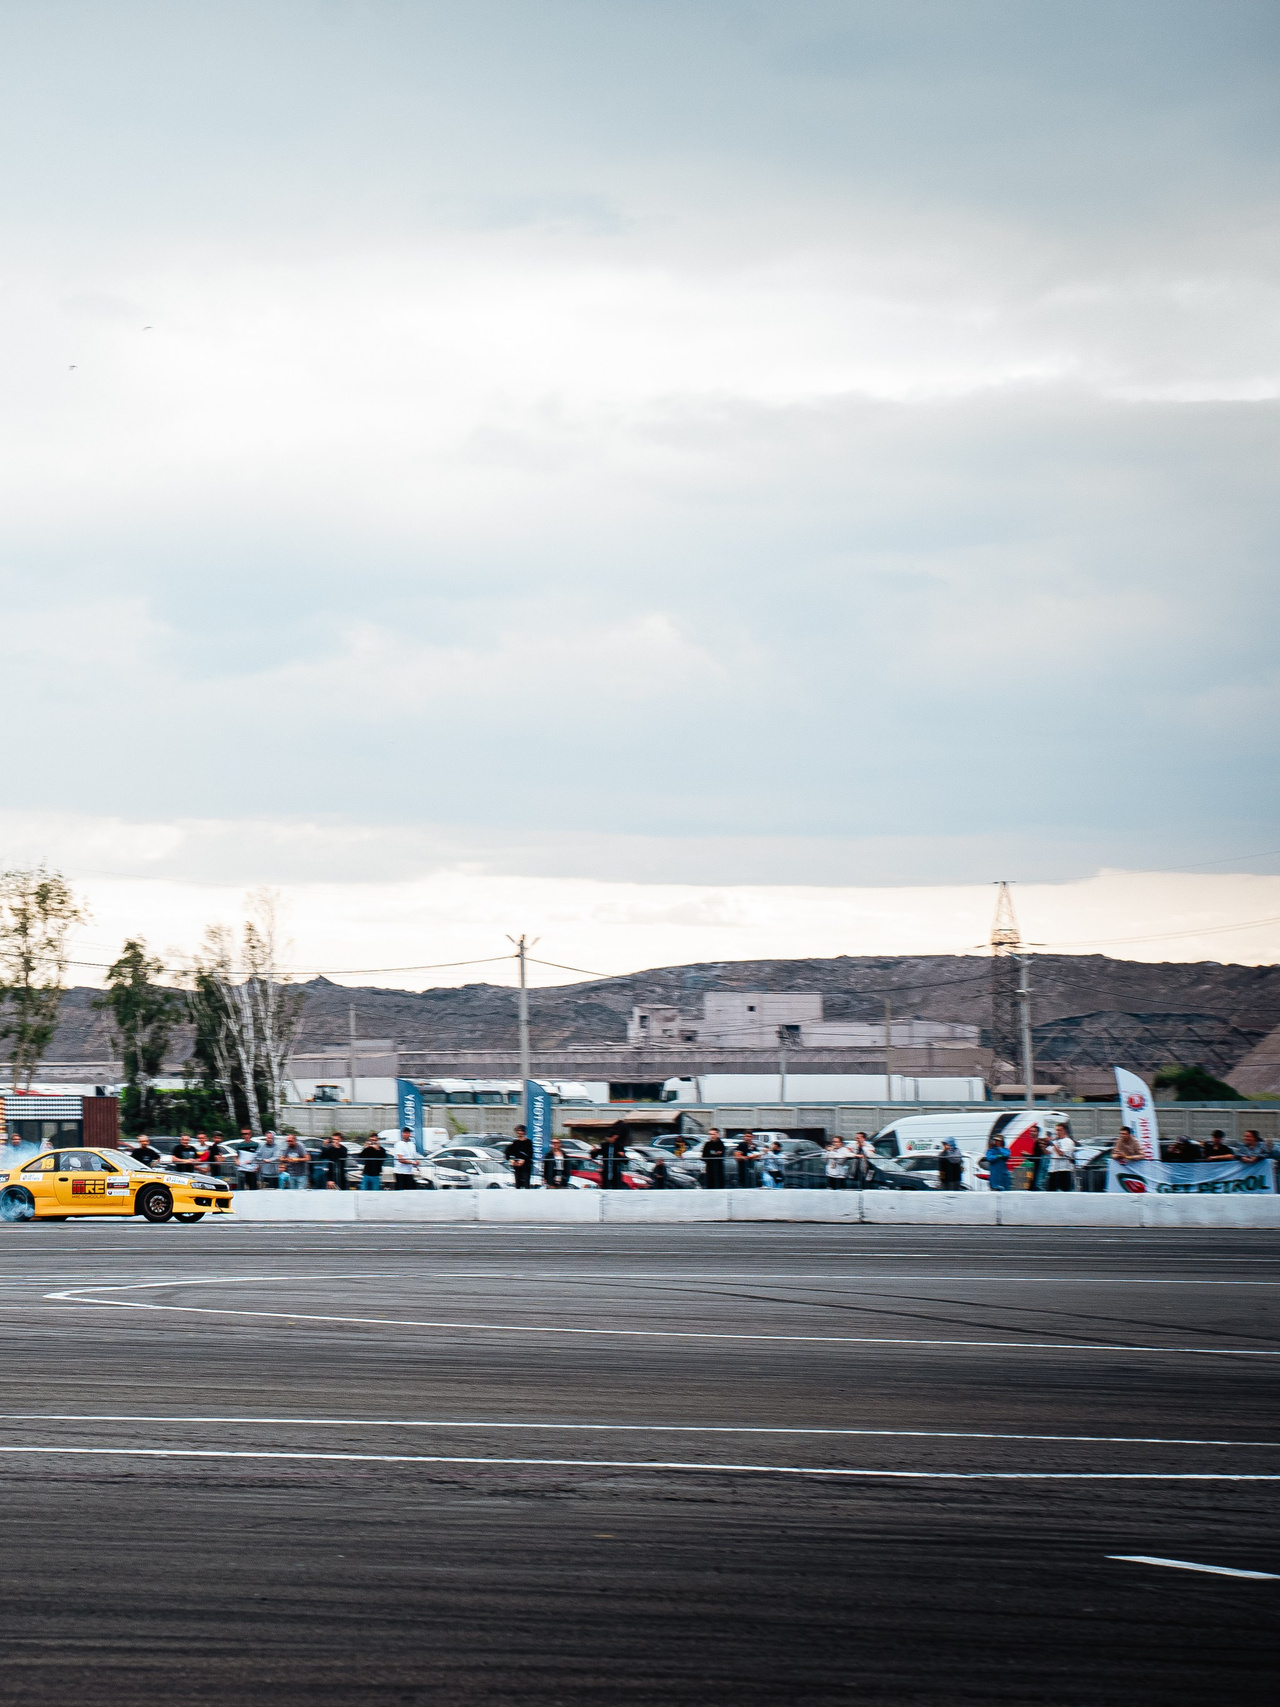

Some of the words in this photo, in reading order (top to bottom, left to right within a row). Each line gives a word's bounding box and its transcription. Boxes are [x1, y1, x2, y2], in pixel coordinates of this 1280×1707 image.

[41, 1158, 55, 1169] 19
[1156, 1183, 1196, 1194] GET
[1197, 1174, 1271, 1194] PETROL
